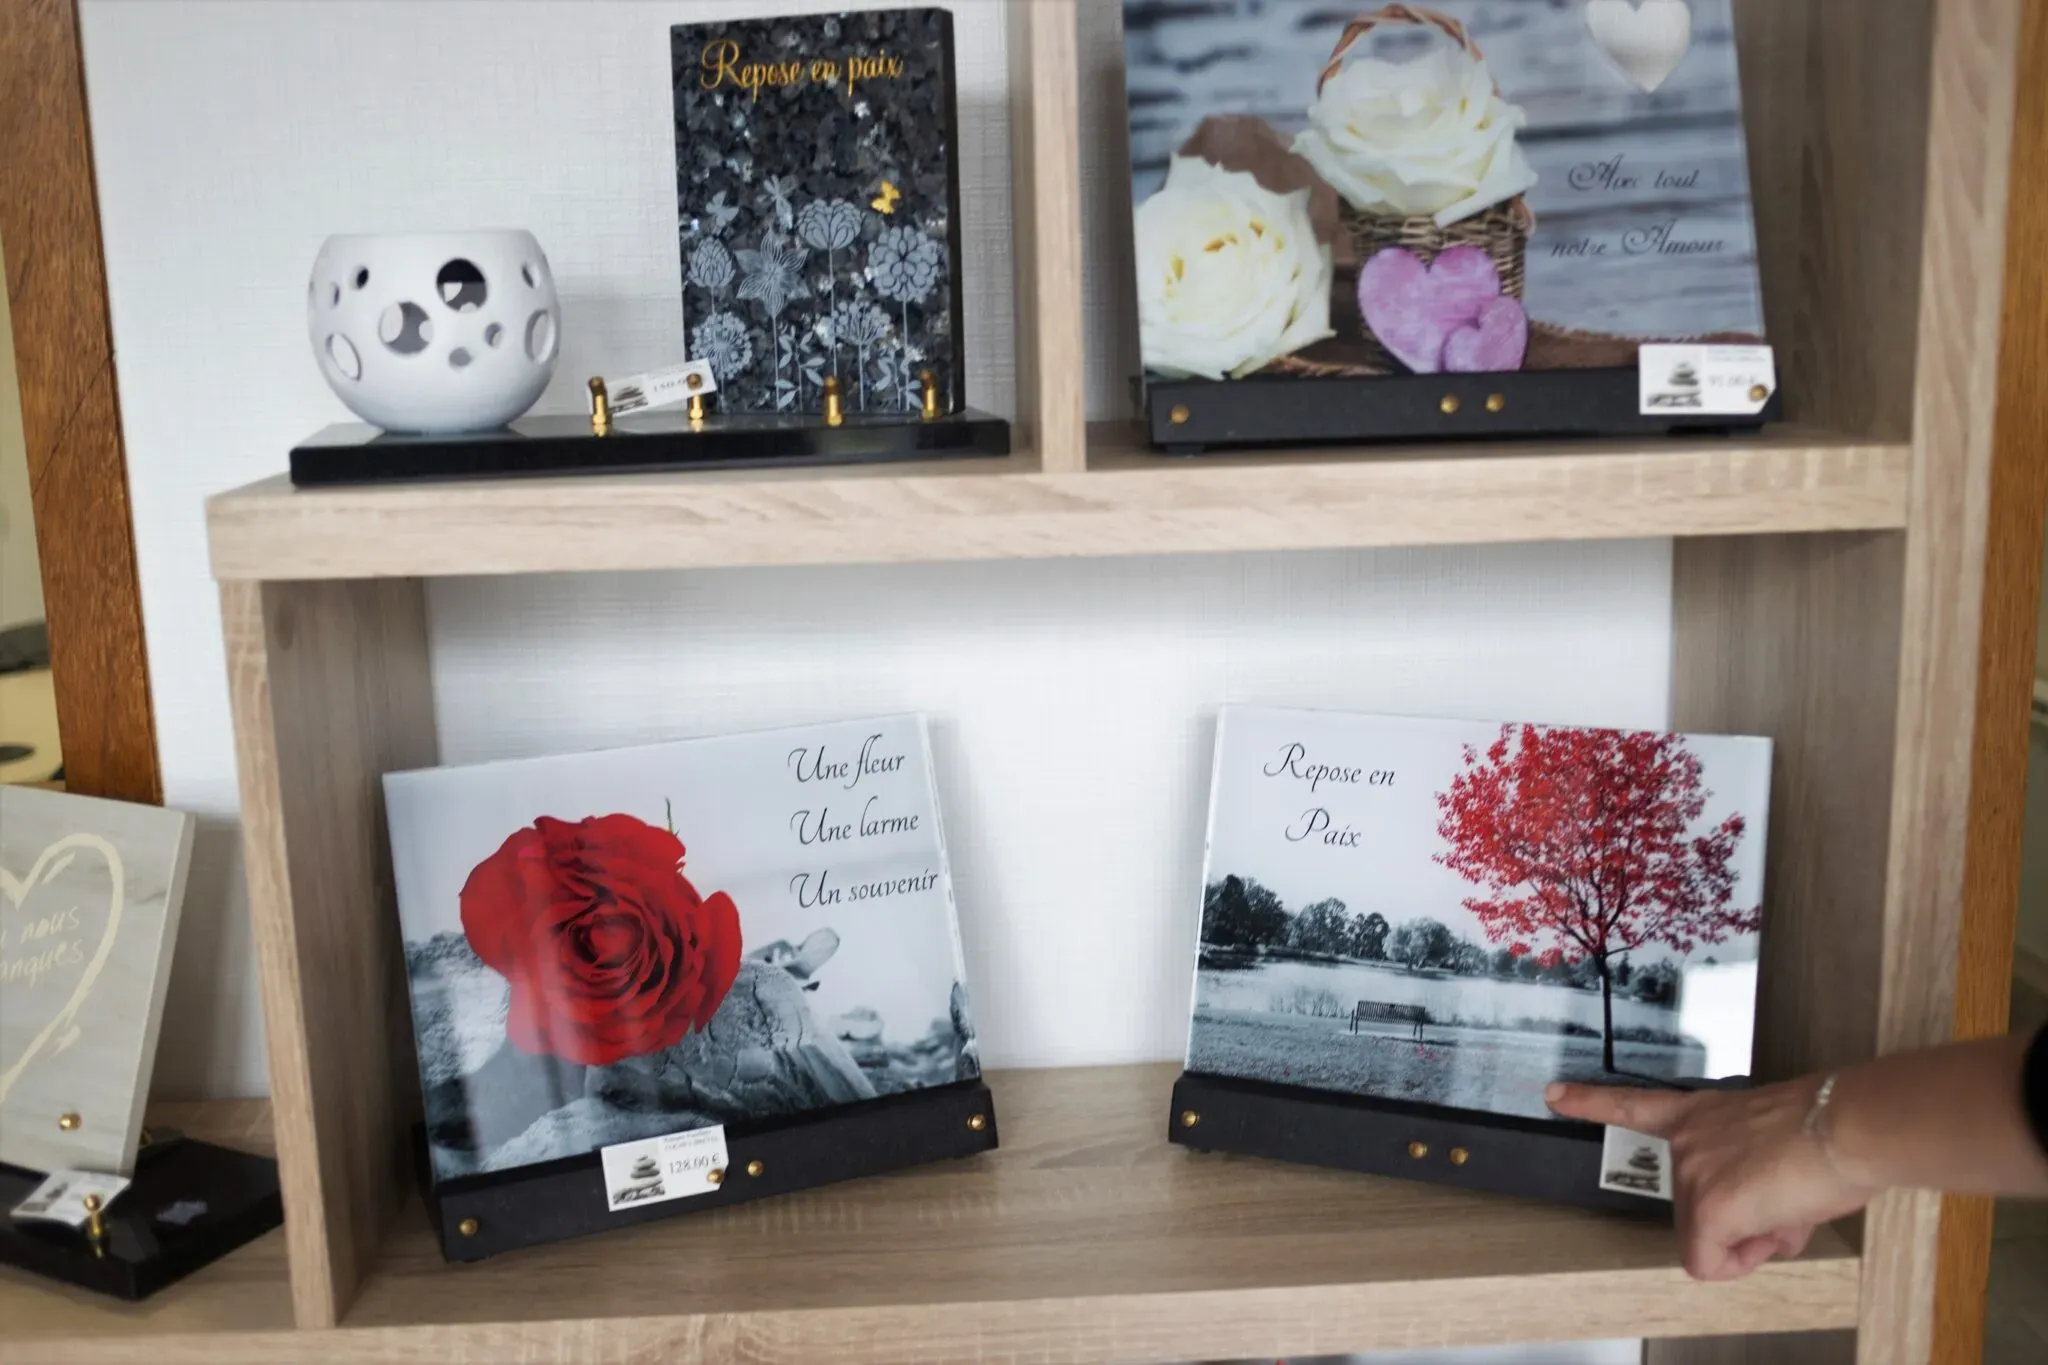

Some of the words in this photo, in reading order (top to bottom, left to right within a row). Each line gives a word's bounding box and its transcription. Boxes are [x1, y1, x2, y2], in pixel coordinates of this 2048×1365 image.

[701, 40, 804, 103] Repose
[811, 58, 842, 82] en
[848, 48, 904, 97] paix
[1654, 168, 1700, 189] tout
[1550, 237, 1608, 258] notre
[1621, 217, 1727, 256] Amour
[788, 745, 849, 783] Une
[843, 733, 905, 790] fleur
[1263, 742, 1362, 793] Repose
[1369, 769, 1396, 787] en
[790, 807, 852, 845] Une
[860, 795, 919, 838] larme
[1285, 807, 1362, 848] Paix
[790, 869, 842, 909] Un
[848, 868, 939, 902] souvenir
[20, 905, 80, 944] nous
